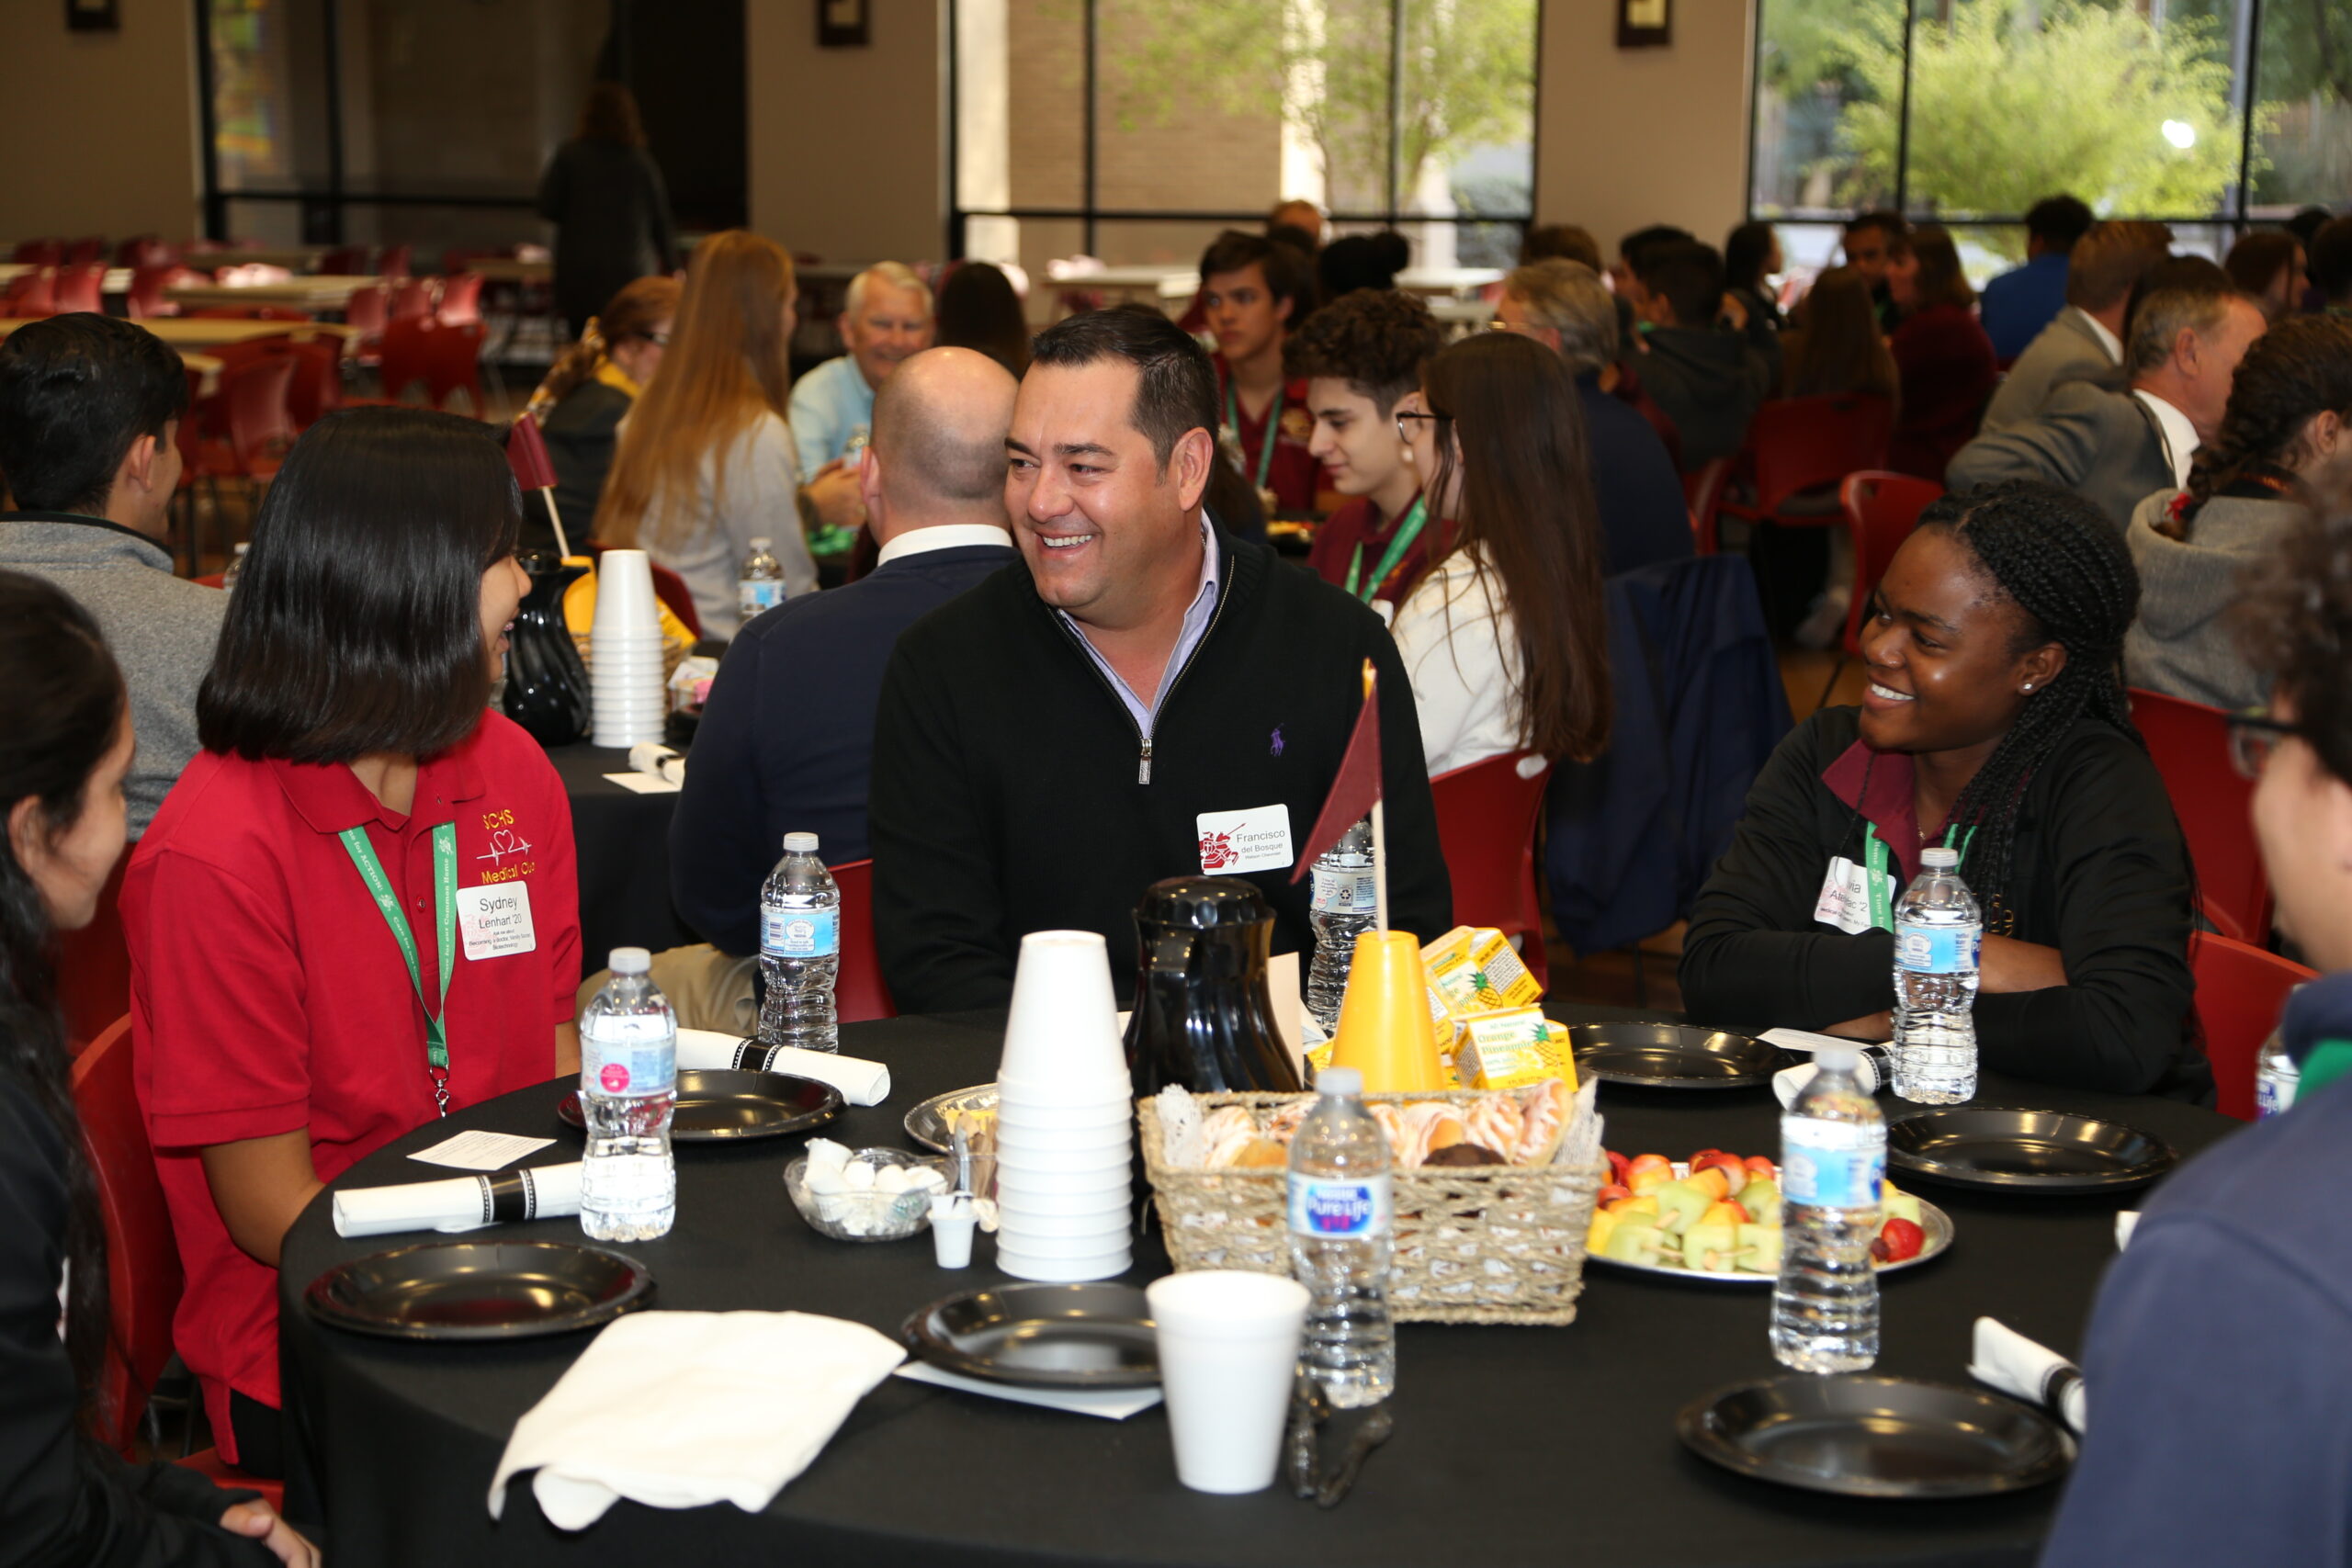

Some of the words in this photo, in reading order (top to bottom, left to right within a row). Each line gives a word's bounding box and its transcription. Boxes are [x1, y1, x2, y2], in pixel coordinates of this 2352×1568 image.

[1237, 830, 1285, 843] Francisco
[1254, 843, 1283, 852] Bosque
[481, 863, 518, 885] Medical
[479, 897, 517, 914] Sydney
[1860, 901, 1868, 912] '2
[479, 916, 511, 930] Lenhart
[512, 913, 522, 924] '20
[1477, 1032, 1516, 1043] Orange
[1481, 1040, 1532, 1055] Pineapple
[1307, 1195, 1341, 1216] Pure
[1343, 1200, 1371, 1222] Life
